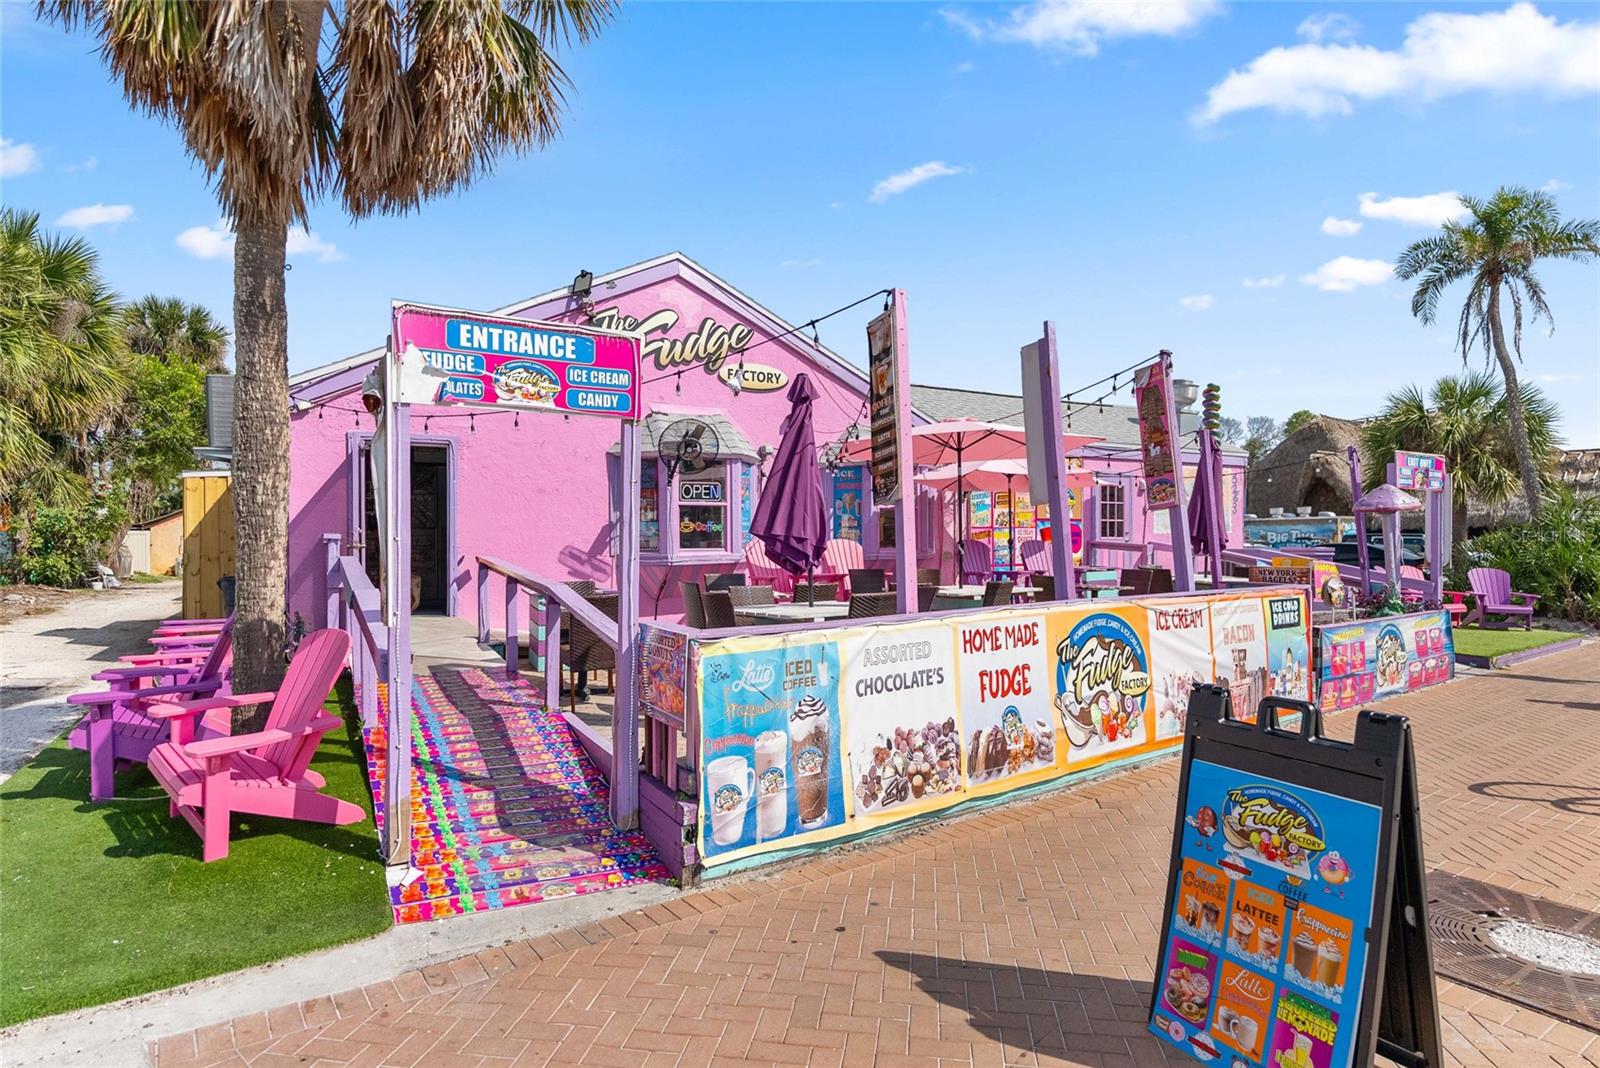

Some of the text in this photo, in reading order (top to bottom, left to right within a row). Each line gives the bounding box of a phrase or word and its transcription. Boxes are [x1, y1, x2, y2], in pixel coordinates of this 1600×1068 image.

[459, 324, 577, 359] ENTRANCE
[593, 306, 753, 374] The Fudge
[505, 368, 550, 388] Fudge
[569, 368, 587, 383] ICE
[590, 371, 629, 386] CREAM
[578, 392, 619, 408] CANDY
[682, 484, 719, 498] OPEN
[695, 520, 723, 532] Coffee
[1275, 569, 1297, 577] YORK
[1272, 601, 1283, 613] ICE
[1283, 600, 1299, 612] COLD
[1154, 609, 1171, 631] ICE
[1172, 608, 1203, 629] CREAM
[1273, 612, 1299, 626] DRINKS
[962, 622, 1039, 654] HOME MADE
[1223, 624, 1255, 646] BACON
[863, 641, 933, 668] ASSORTED
[732, 659, 775, 692] Latte
[785, 659, 813, 677] ICED
[1057, 635, 1134, 705] The Fudge
[783, 676, 817, 691] COFFEE
[855, 666, 945, 698] CHOCOLATE'S
[979, 664, 1031, 703] FUDGE
[1121, 677, 1148, 690] FACTORY
[1228, 789, 1308, 835] The Fudge
[1288, 833, 1322, 849] FACTORY
[1277, 883, 1308, 902] COFFEE
[1236, 900, 1279, 926] LATTEE
[1225, 968, 1270, 1001] Latte
[1276, 1008, 1335, 1046] LEMONADE
